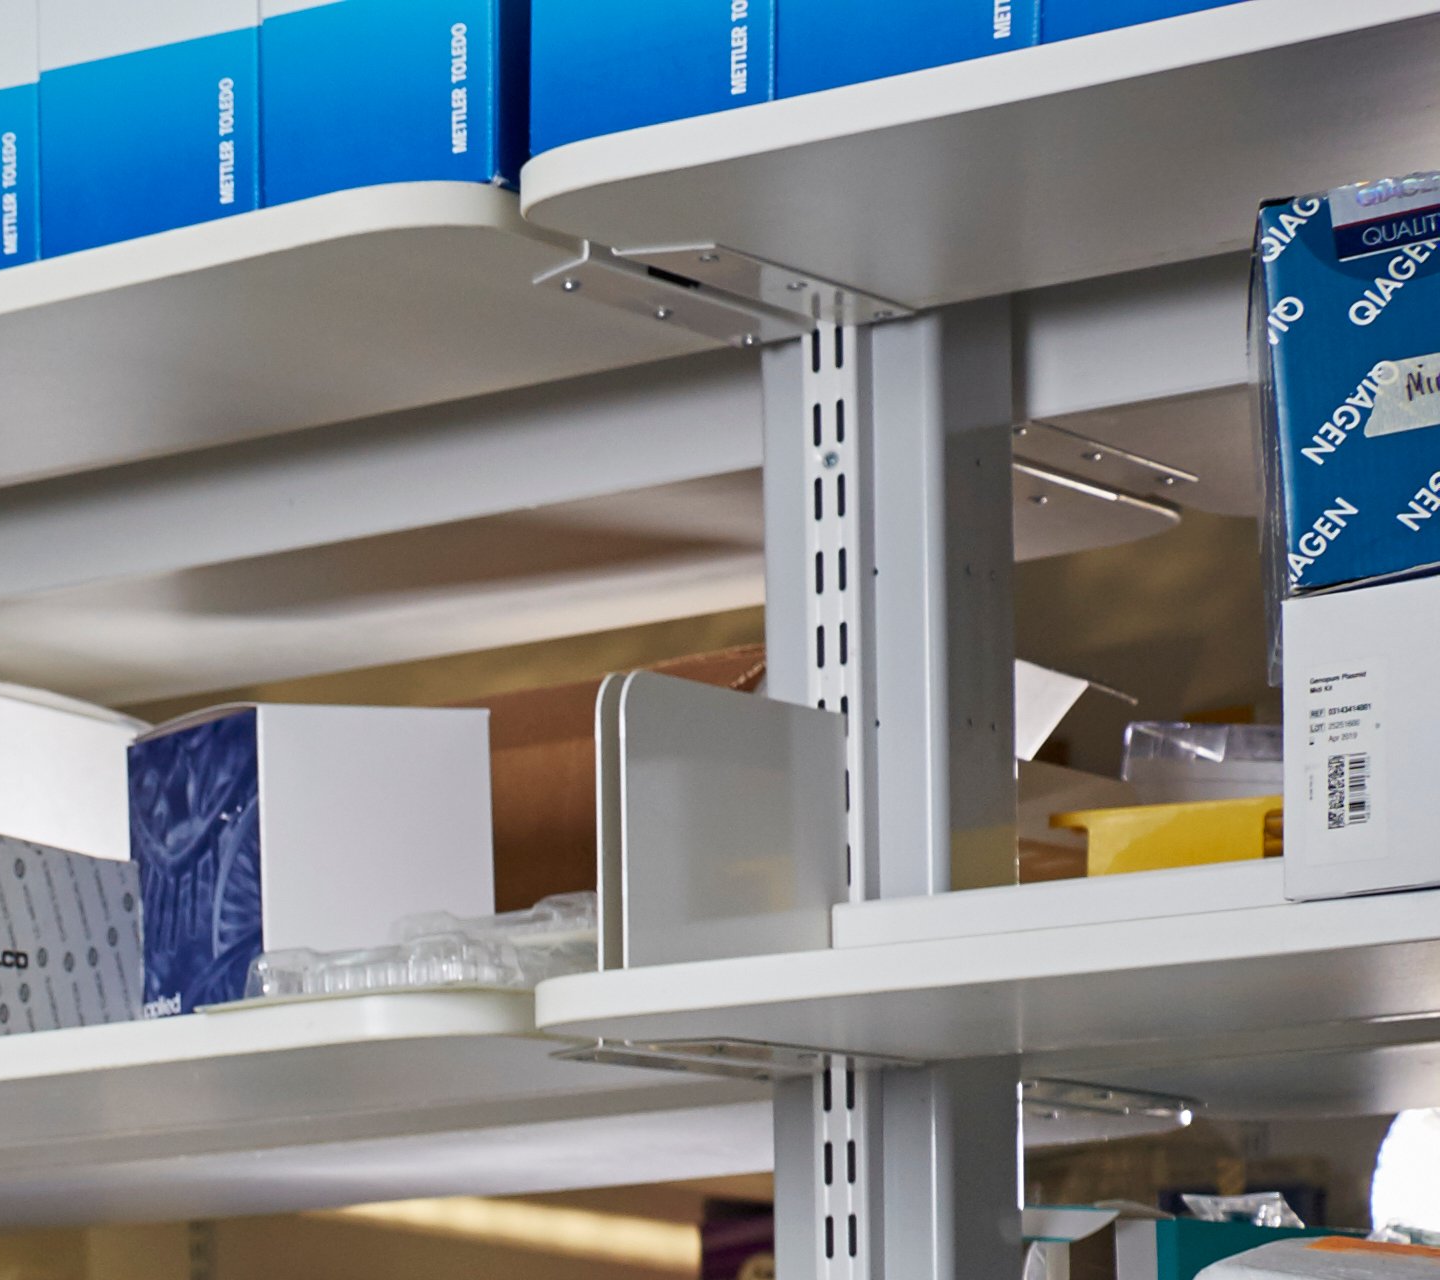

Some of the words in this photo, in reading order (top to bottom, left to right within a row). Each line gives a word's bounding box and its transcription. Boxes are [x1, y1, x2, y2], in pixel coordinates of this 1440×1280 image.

[730, 0, 747, 21] TO
[451, 22, 467, 83] TOLEDO
[730, 25, 748, 96] METTLER
[219, 77, 235, 136] TOLEDO
[452, 88, 468, 154] METTLER
[2, 131, 17, 186] TOLEDO
[220, 140, 236, 204] METTLER
[2, 193, 19, 255] METTLER
[1301, 360, 1400, 466] QIAGEN
